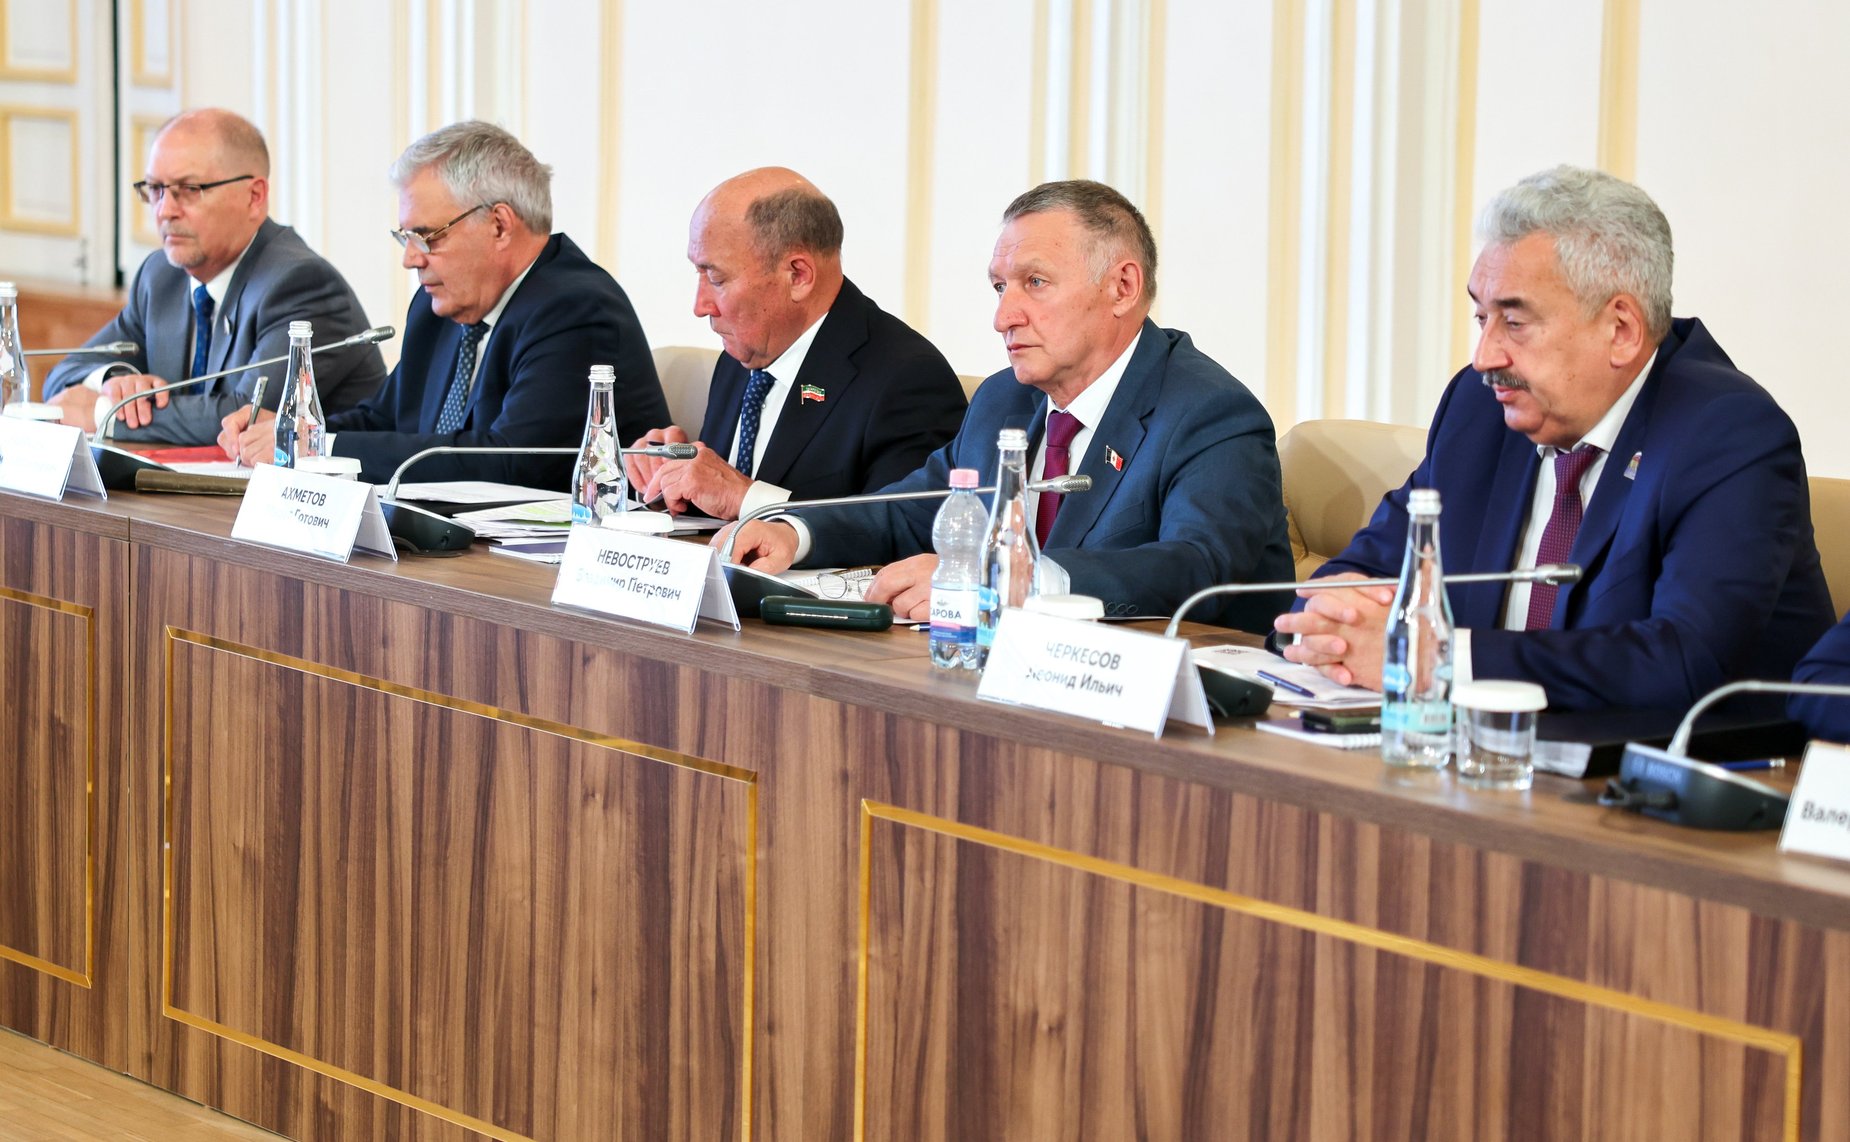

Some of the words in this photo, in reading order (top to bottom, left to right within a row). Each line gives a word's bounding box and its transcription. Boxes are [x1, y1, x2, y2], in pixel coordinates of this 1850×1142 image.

[281, 486, 327, 507] АХМЕТОВ
[597, 548, 671, 575] НЕВОСТРУЕВ
[627, 577, 682, 600] Петрович
[930, 607, 962, 619] АРОВА
[1046, 641, 1122, 670] ЧЕРКЕСОВ
[1079, 673, 1124, 697] Ильич
